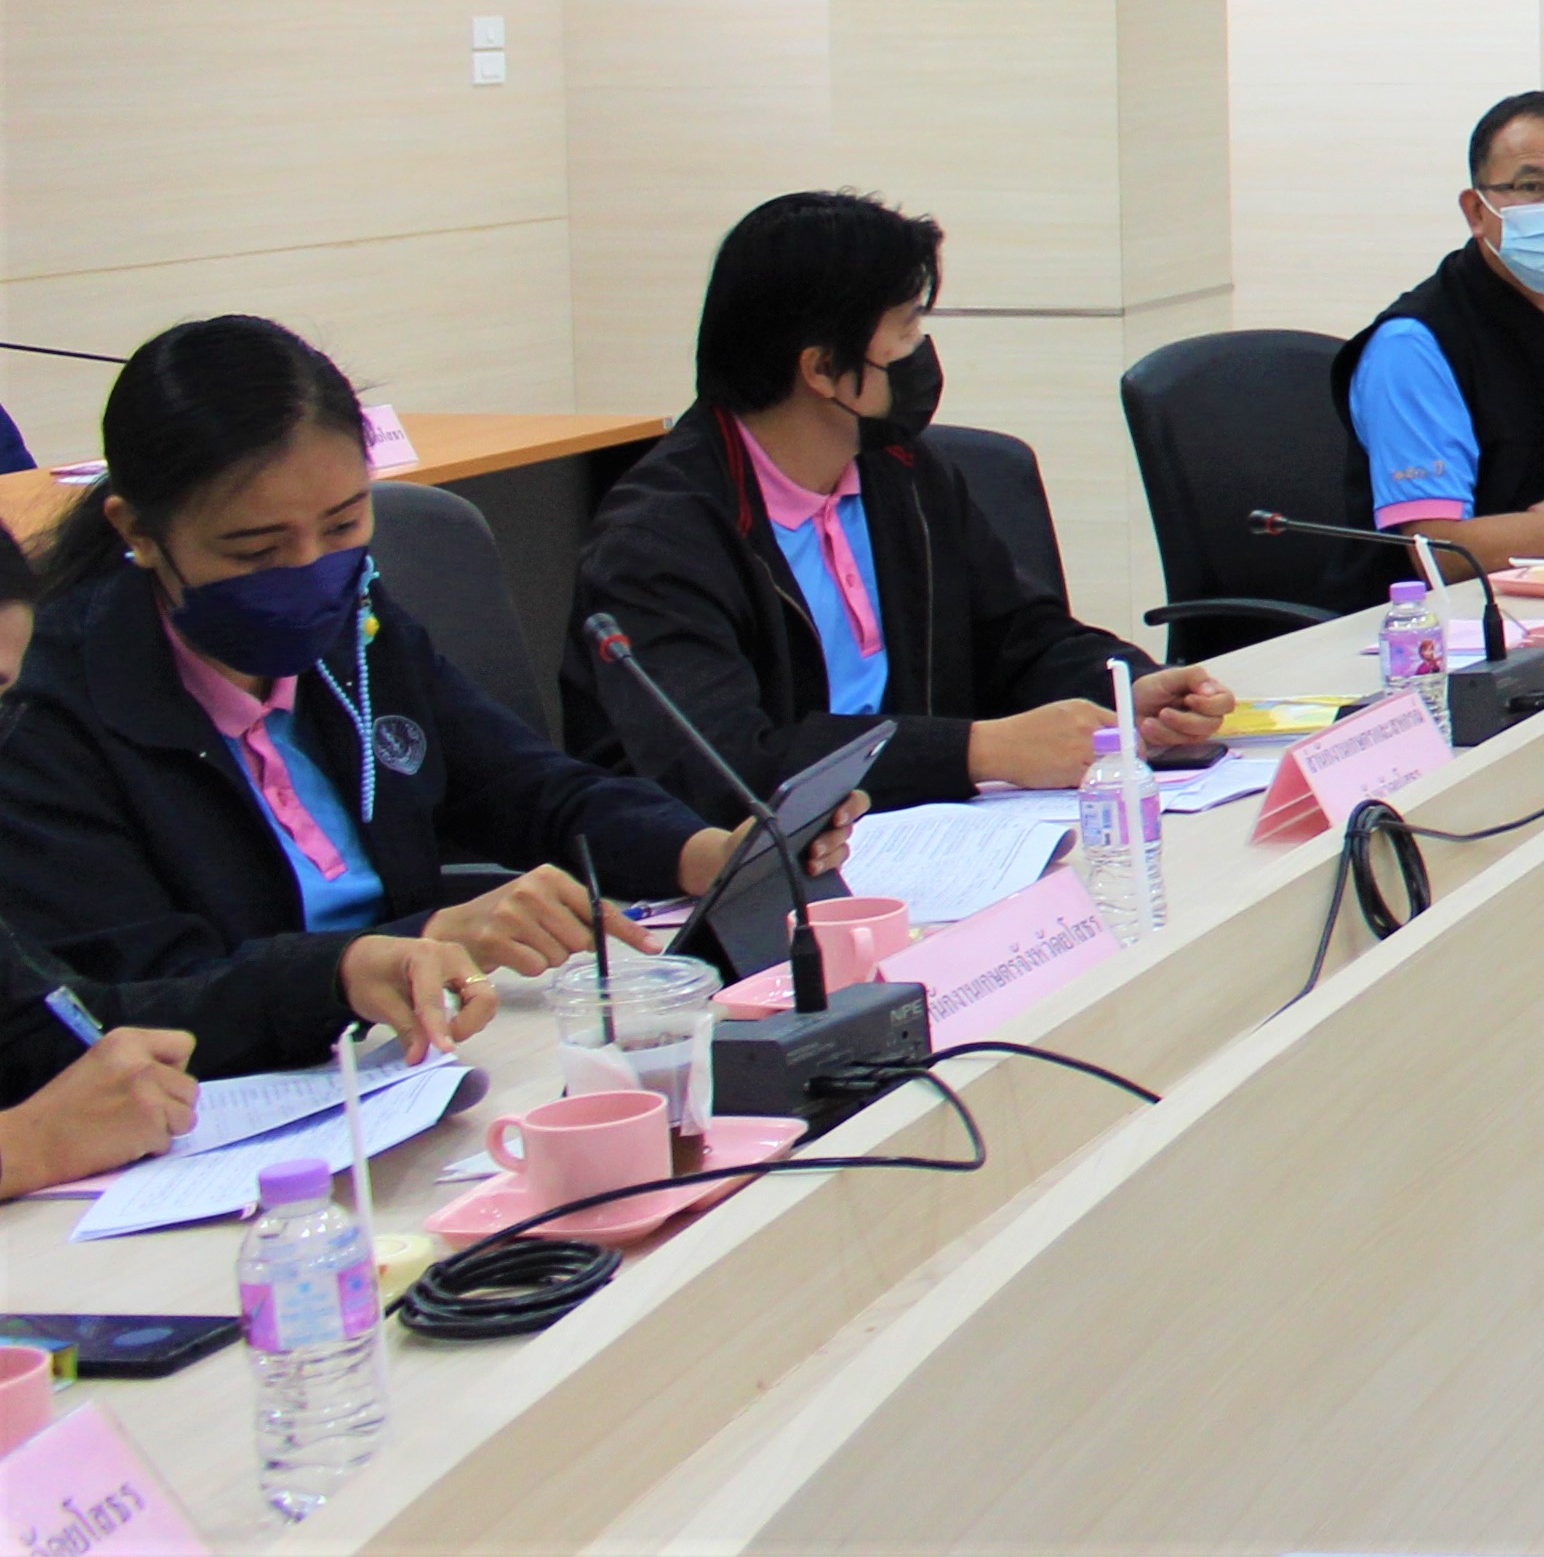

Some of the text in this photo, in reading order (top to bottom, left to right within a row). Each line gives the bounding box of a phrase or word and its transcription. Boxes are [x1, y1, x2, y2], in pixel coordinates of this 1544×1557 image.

[927, 916, 1104, 1024] ำนักงานเกษตรจังหวัดยโสธร
